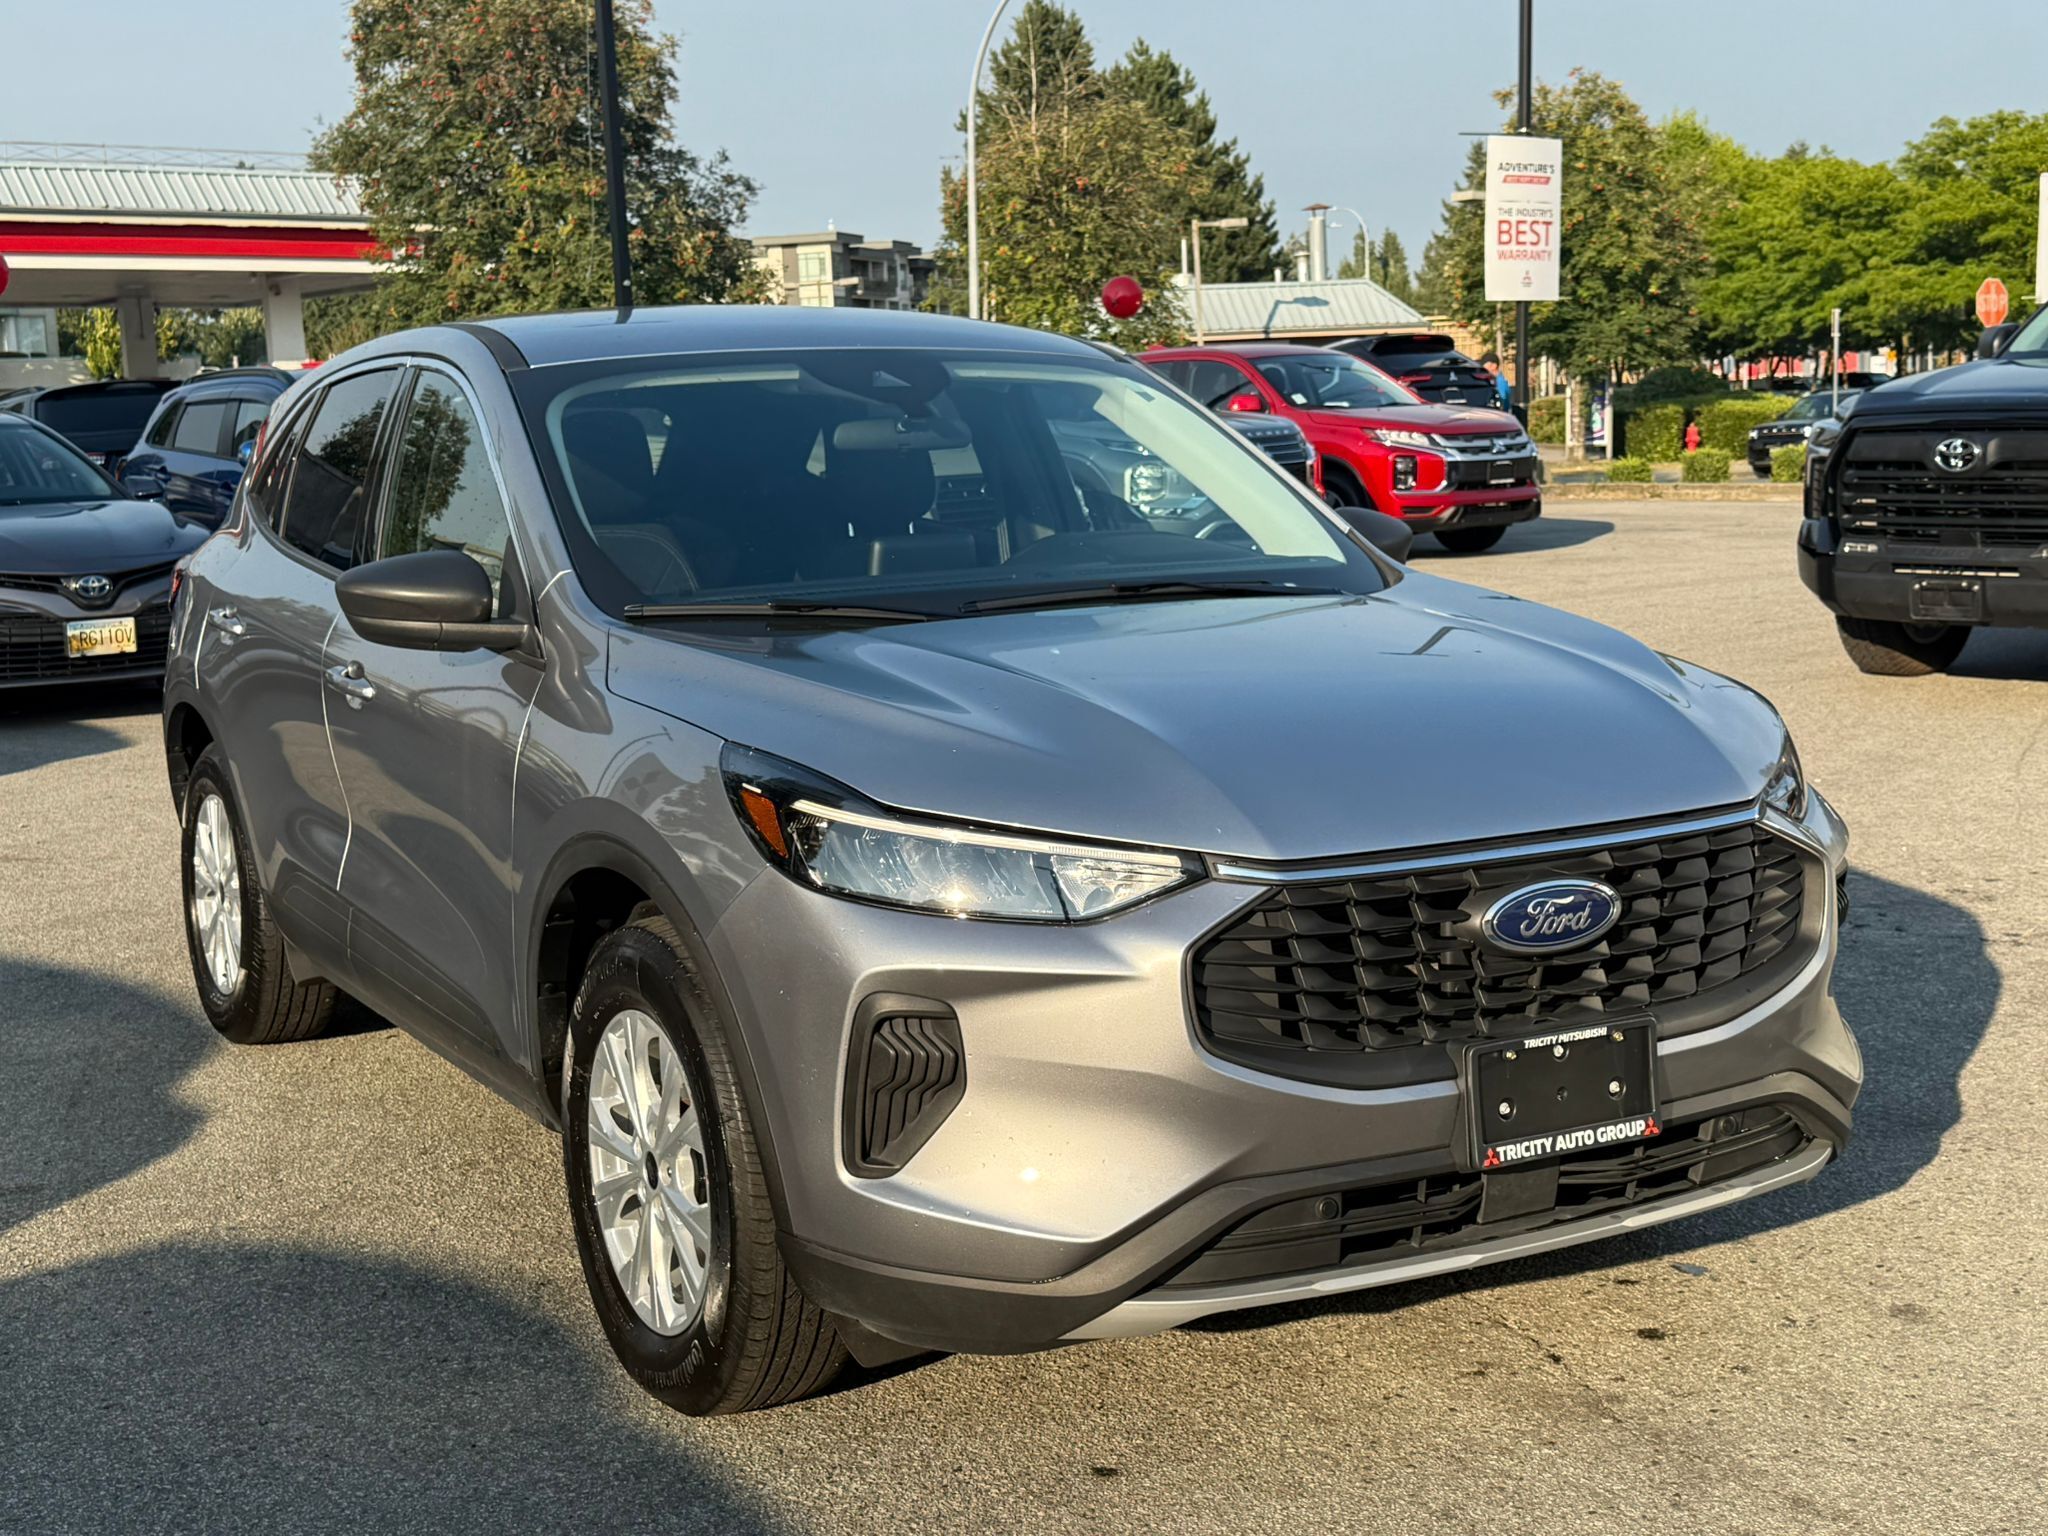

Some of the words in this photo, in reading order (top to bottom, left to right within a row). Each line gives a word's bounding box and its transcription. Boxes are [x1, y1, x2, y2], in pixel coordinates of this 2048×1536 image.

[1497, 162, 1555, 174] ADVENTURE'S
[1498, 207, 1513, 217] THE
[1515, 208, 1553, 219] INDUSTRY'S
[1497, 219, 1553, 247] BEST
[1497, 249, 1552, 262] WARRANTY
[1520, 895, 1592, 939] Ford
[1524, 1034, 1559, 1049] TRICITY
[1558, 1026, 1608, 1045] MITSUBISHI
[1496, 1136, 1553, 1162] TRICITY
[1555, 1128, 1595, 1151] AUTO
[1597, 1118, 1646, 1143] GROUP
